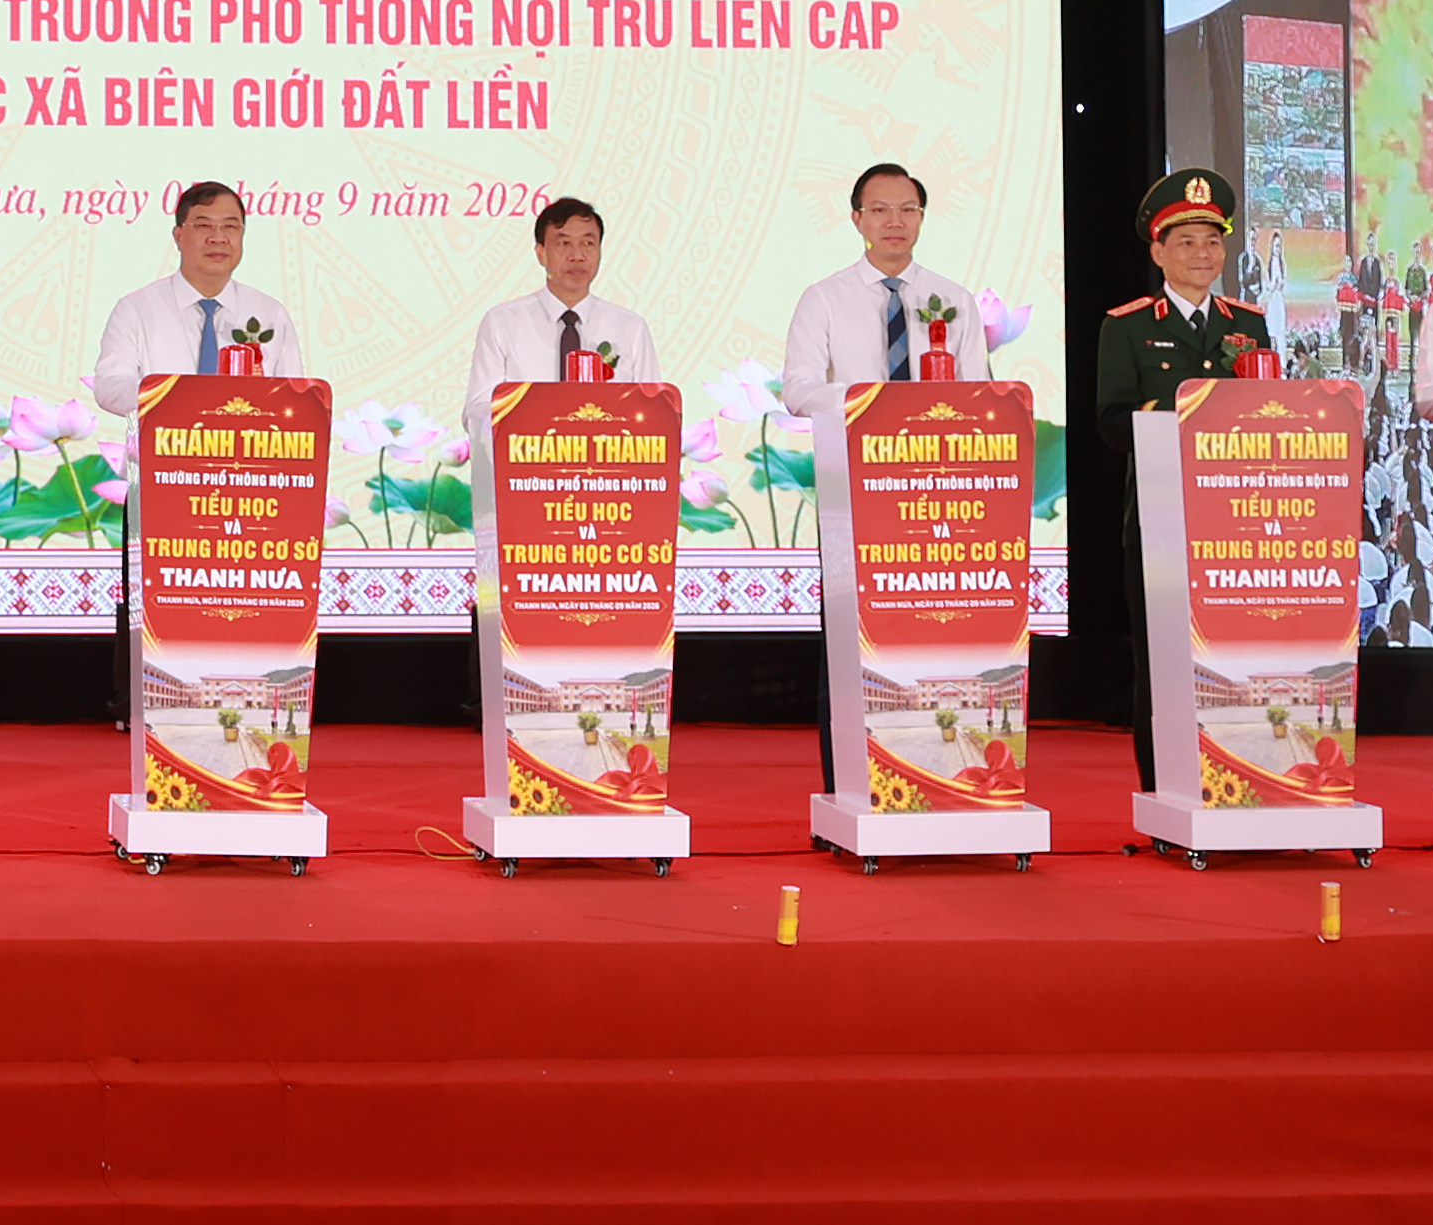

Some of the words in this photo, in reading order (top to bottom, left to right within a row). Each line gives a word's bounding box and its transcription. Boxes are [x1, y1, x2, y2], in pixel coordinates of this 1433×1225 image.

[25, 67, 88, 126] XÃ
[105, 67, 214, 127] BIÊN
[233, 68, 324, 129] GIỚI
[341, 62, 431, 130] ĐẤT
[447, 63, 549, 130] LIỀN
[62, 181, 149, 225] ngày
[236, 180, 325, 226] háng
[338, 181, 359, 216] 9
[370, 181, 450, 217] năm
[463, 182, 552, 217] 2026
[154, 421, 236, 458] KHÁNH
[240, 424, 316, 460] THÀNH
[508, 428, 588, 463] KHÁNH
[593, 429, 667, 463] THÀNH
[861, 428, 940, 463] KHÁNH
[945, 428, 1018, 461] THÀNH
[1194, 426, 1272, 460] KHÁNH
[1276, 426, 1348, 459] THÀNH
[159, 567, 245, 589] THANH
[250, 566, 303, 590] NƯA
[872, 572, 956, 592] THANH
[960, 568, 1012, 590] NƯA
